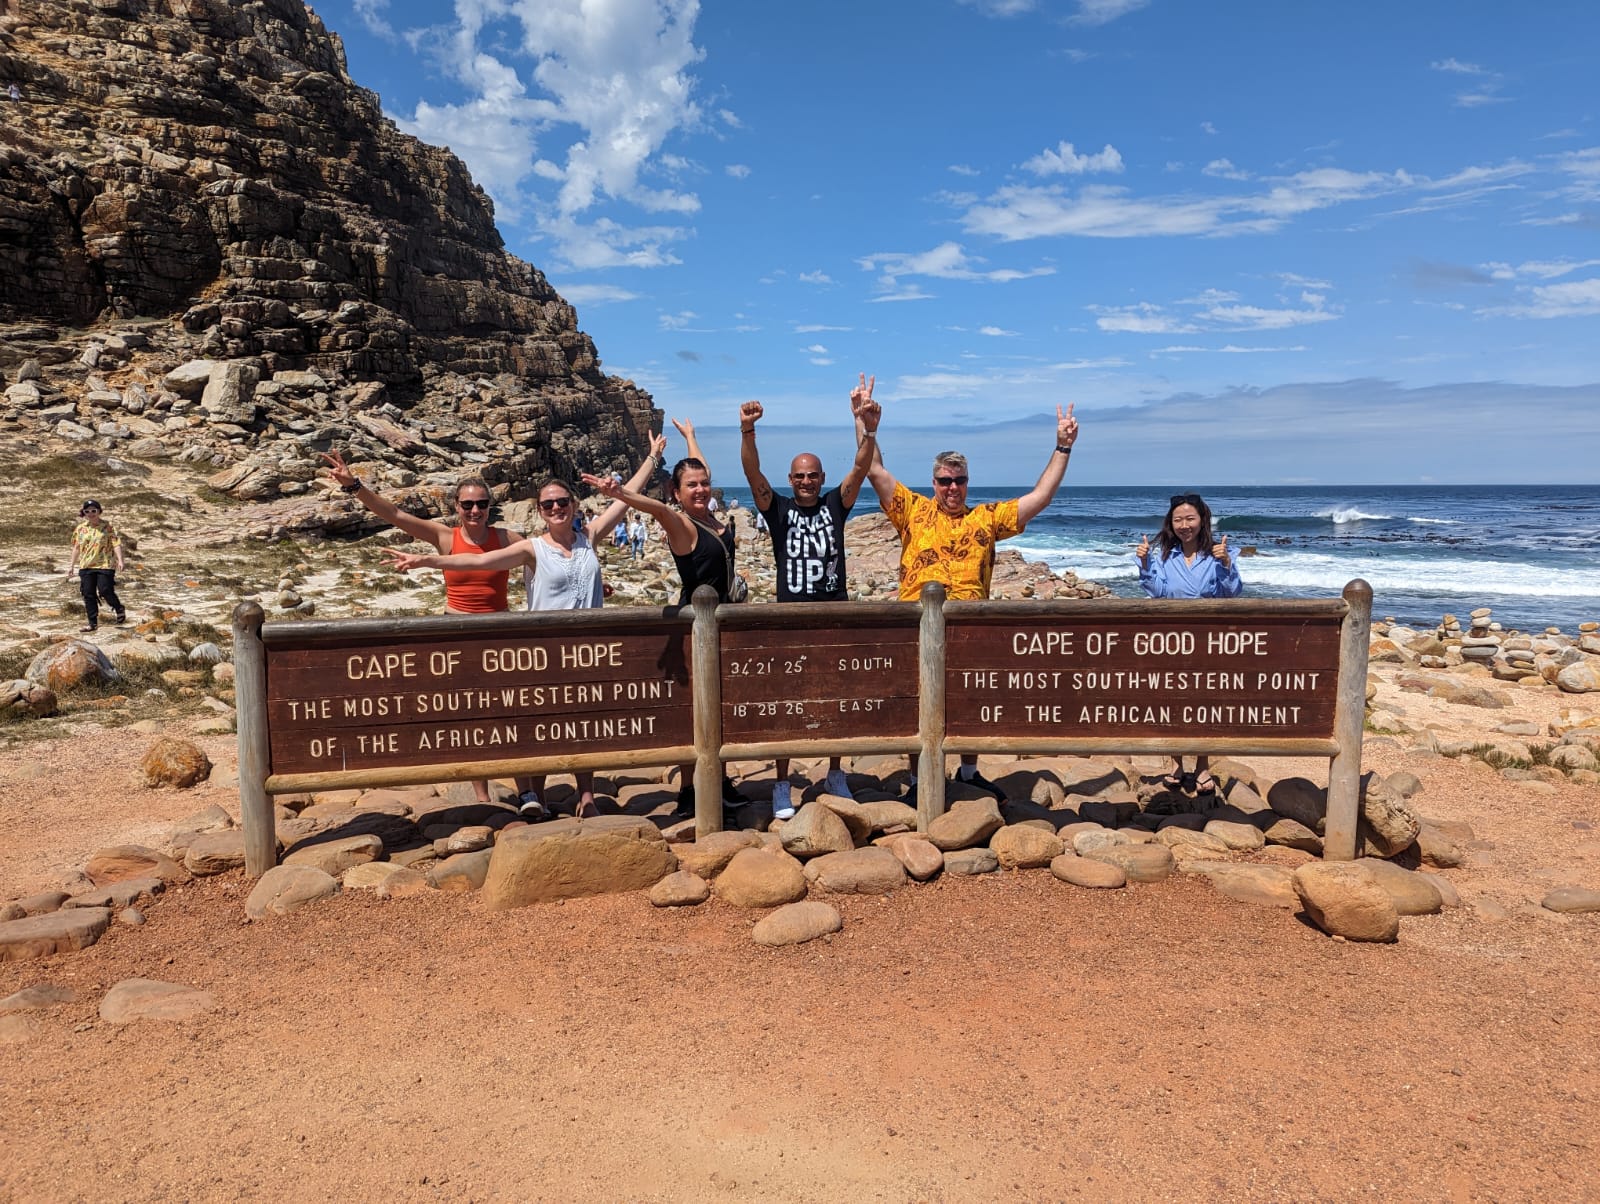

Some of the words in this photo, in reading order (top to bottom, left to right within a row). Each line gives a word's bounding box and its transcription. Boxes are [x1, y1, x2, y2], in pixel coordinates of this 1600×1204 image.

[787, 505, 833, 534] NEVER
[786, 525, 838, 558] GIVE
[1013, 632, 1074, 655] CAPE
[1086, 632, 1119, 655] OF
[1133, 631, 1195, 655] GOOD
[1207, 632, 1268, 655] HOPE
[347, 652, 417, 680] CAPE
[430, 651, 461, 676] OF
[482, 647, 548, 672] GOOD
[560, 642, 623, 668] HOPE
[838, 657, 893, 671] SOUTH
[962, 672, 998, 689] THE
[1008, 672, 1061, 689] MOST
[1072, 672, 1244, 690] SOUTH-WESTERN
[1257, 672, 1319, 690] POINT
[288, 699, 332, 720] THE
[344, 696, 404, 717] MOST
[417, 684, 603, 713] SOUTH-WESTERN
[613, 680, 675, 701] POINT
[839, 699, 884, 713] EAST
[981, 705, 1003, 722] OF
[1025, 705, 1062, 723] THE
[1079, 705, 1170, 723] AFRICAN
[1183, 705, 1301, 724] CONTINENT
[310, 737, 337, 758] OF
[357, 733, 399, 753] THE
[419, 724, 518, 750] AFRICAN
[535, 716, 656, 741] CONTINENT
